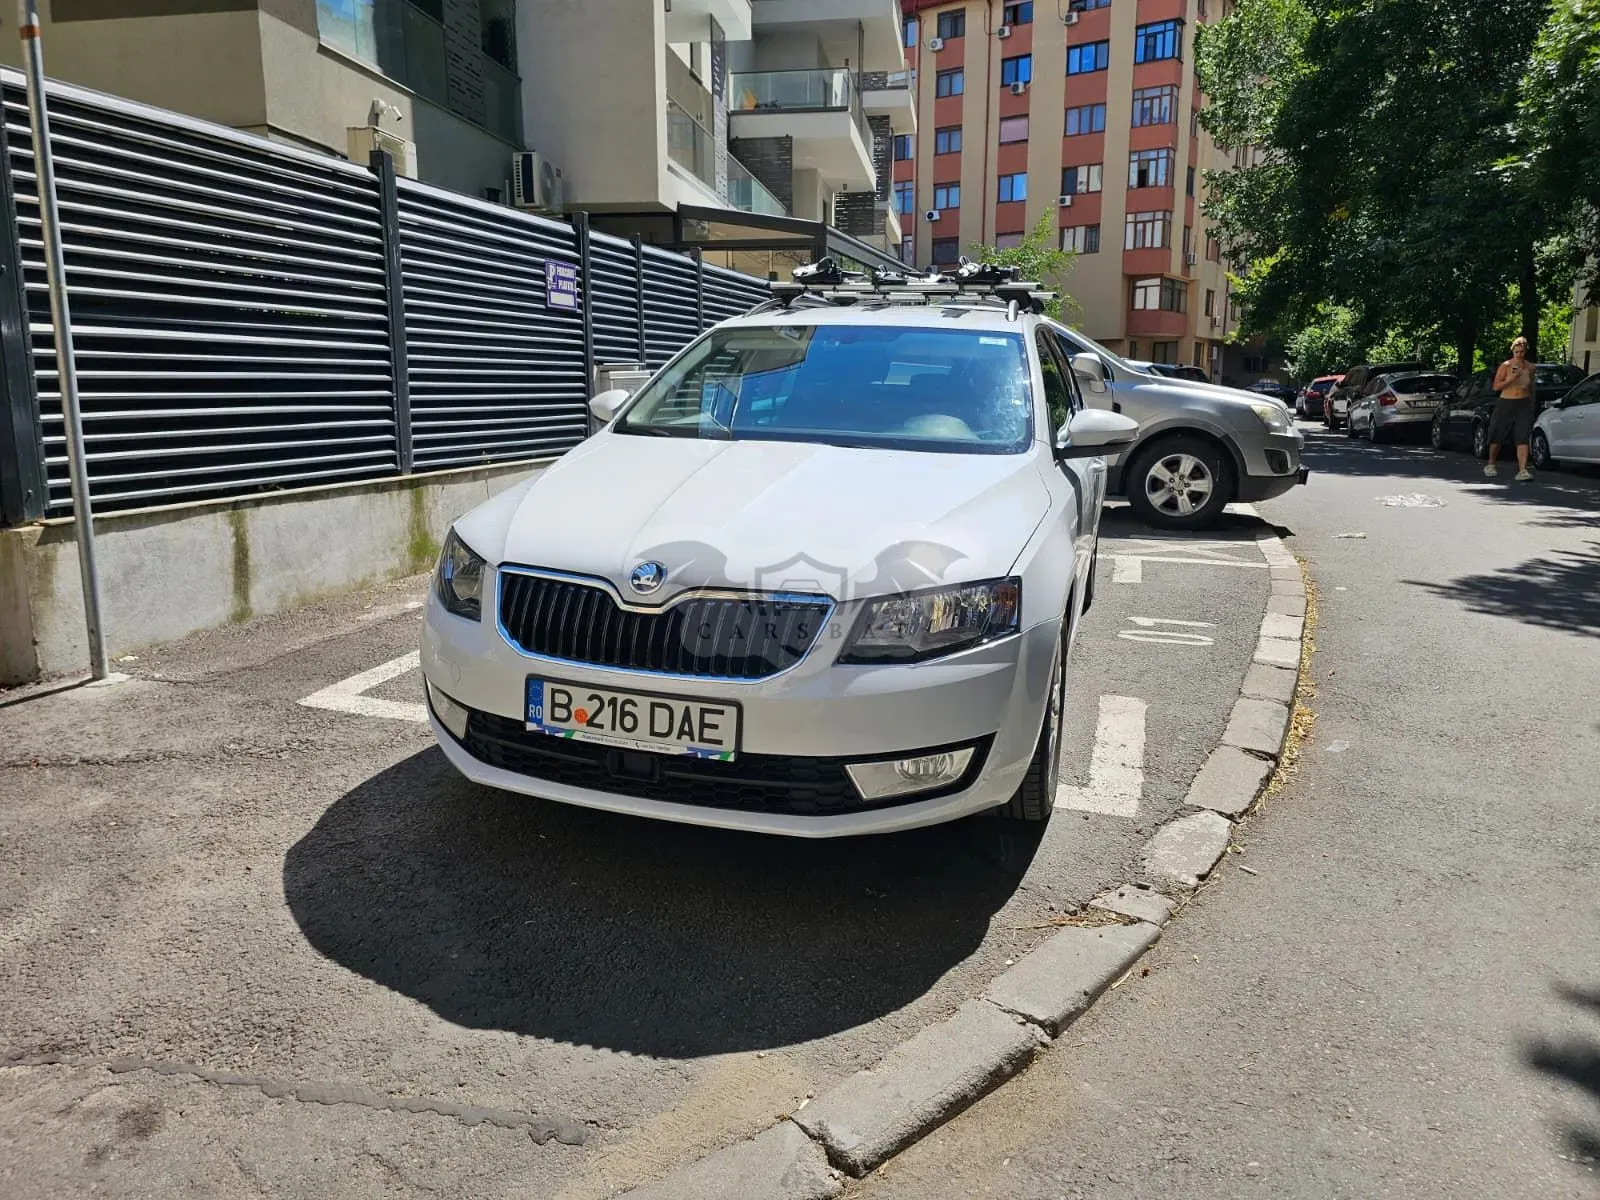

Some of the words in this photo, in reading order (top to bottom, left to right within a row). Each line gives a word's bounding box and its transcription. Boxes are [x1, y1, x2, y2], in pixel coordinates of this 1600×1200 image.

[528, 703, 543, 720] RO
[550, 687, 573, 723] B
[586, 693, 639, 733] 216
[649, 701, 725, 746] DAE
